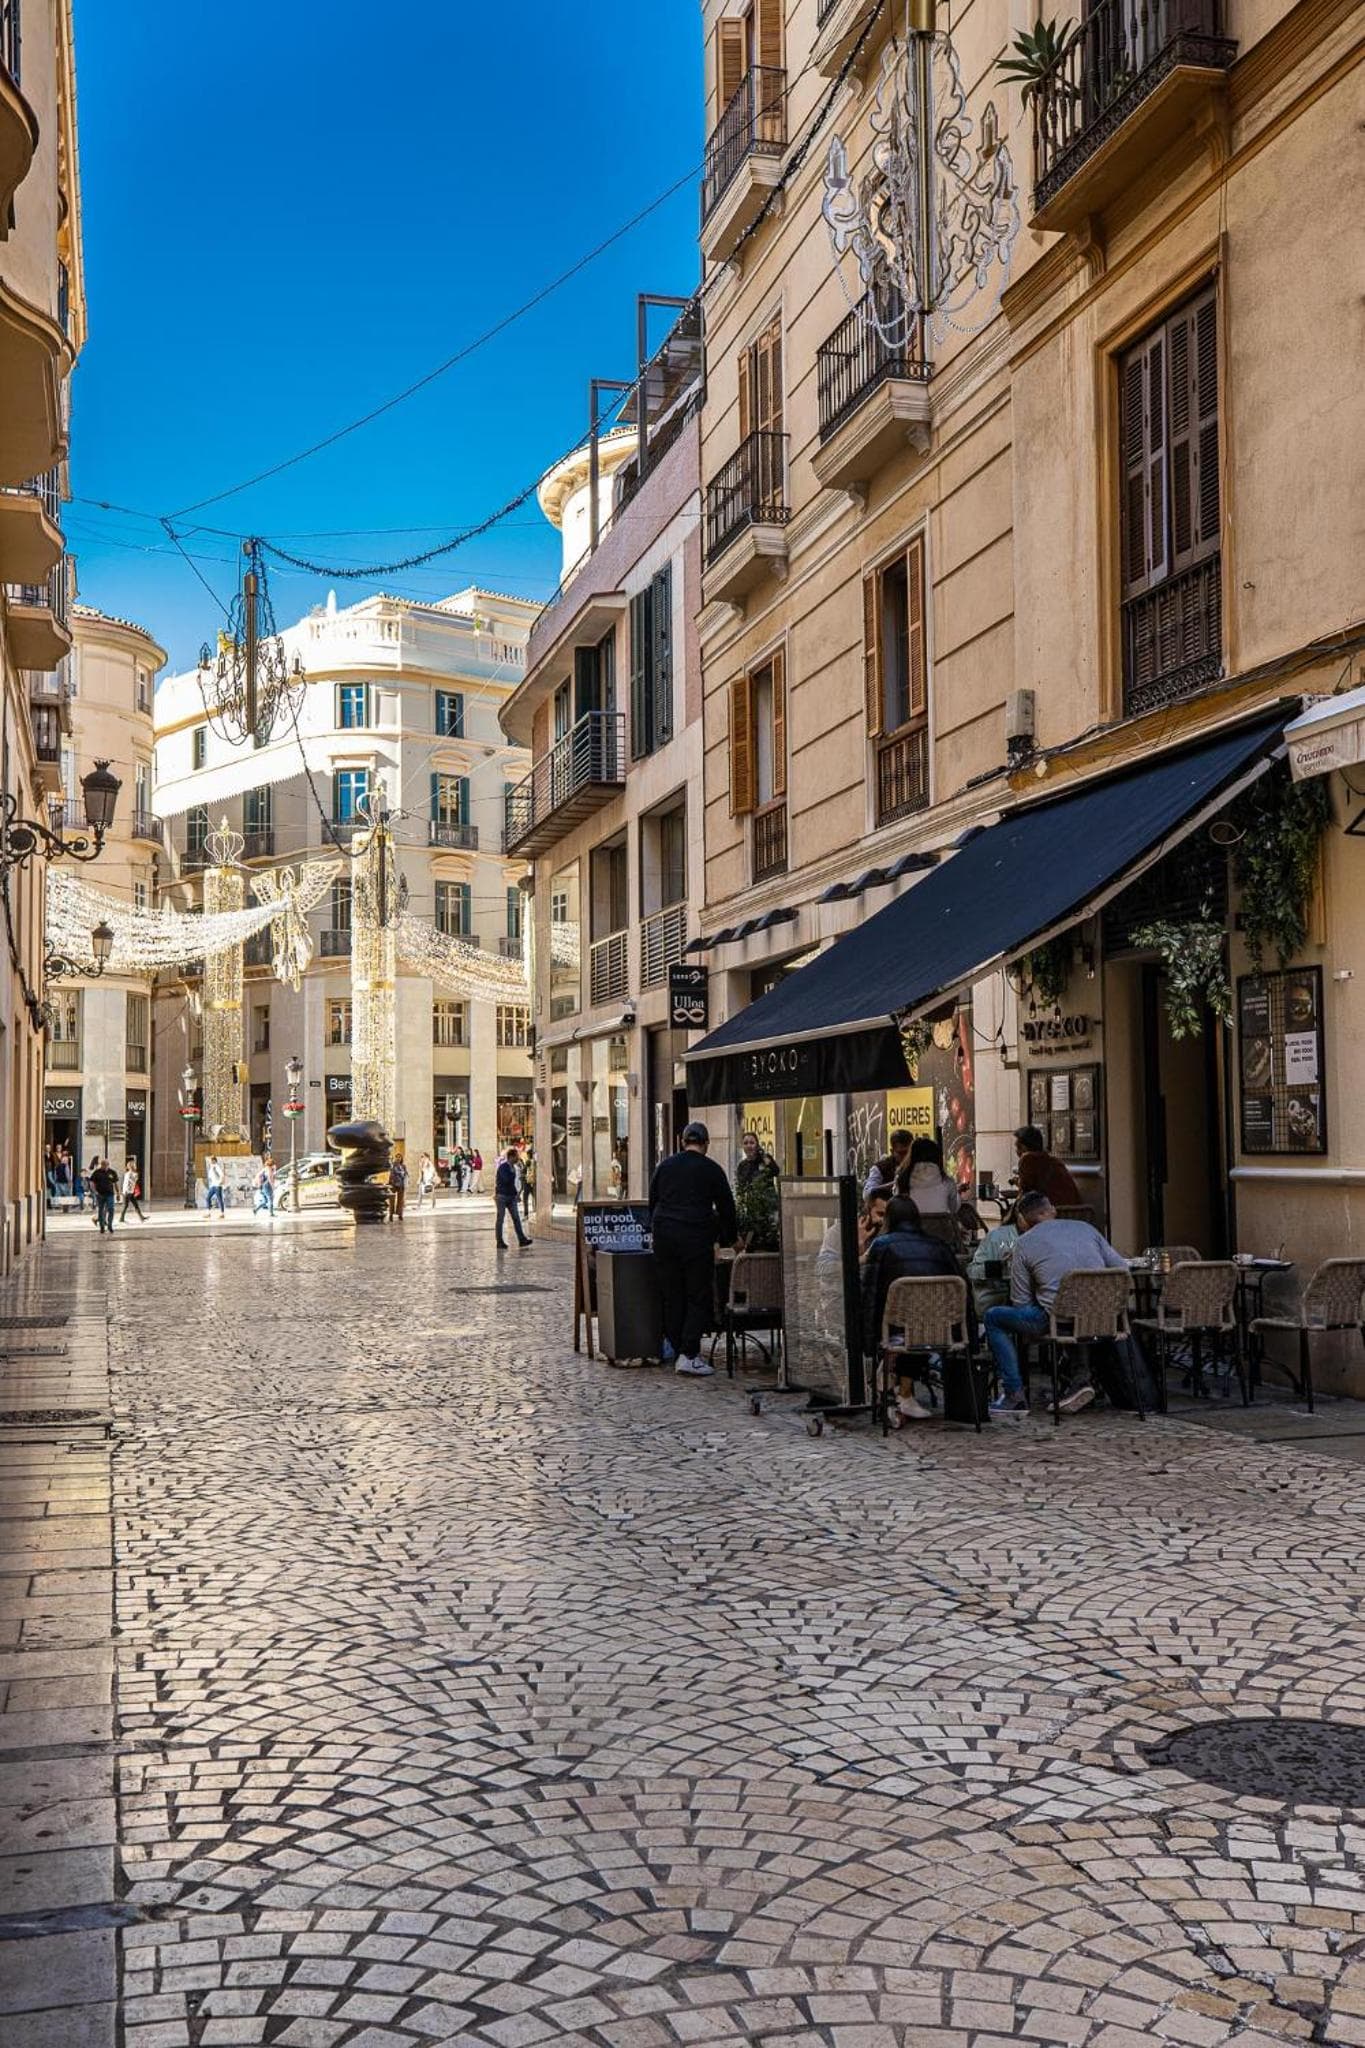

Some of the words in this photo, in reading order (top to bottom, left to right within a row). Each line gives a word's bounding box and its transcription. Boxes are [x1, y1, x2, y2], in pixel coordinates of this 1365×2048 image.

[330, 1078, 353, 1090] Bers
[45, 1099, 75, 1110] NGO
[889, 1106, 931, 1126] QUIERES
[746, 1116, 773, 1135] LOCAL
[583, 1215, 601, 1224] BIO
[584, 1225, 612, 1234] REAL
[614, 1224, 646, 1233] FOOD.
[585, 1235, 620, 1245] LOCAL
